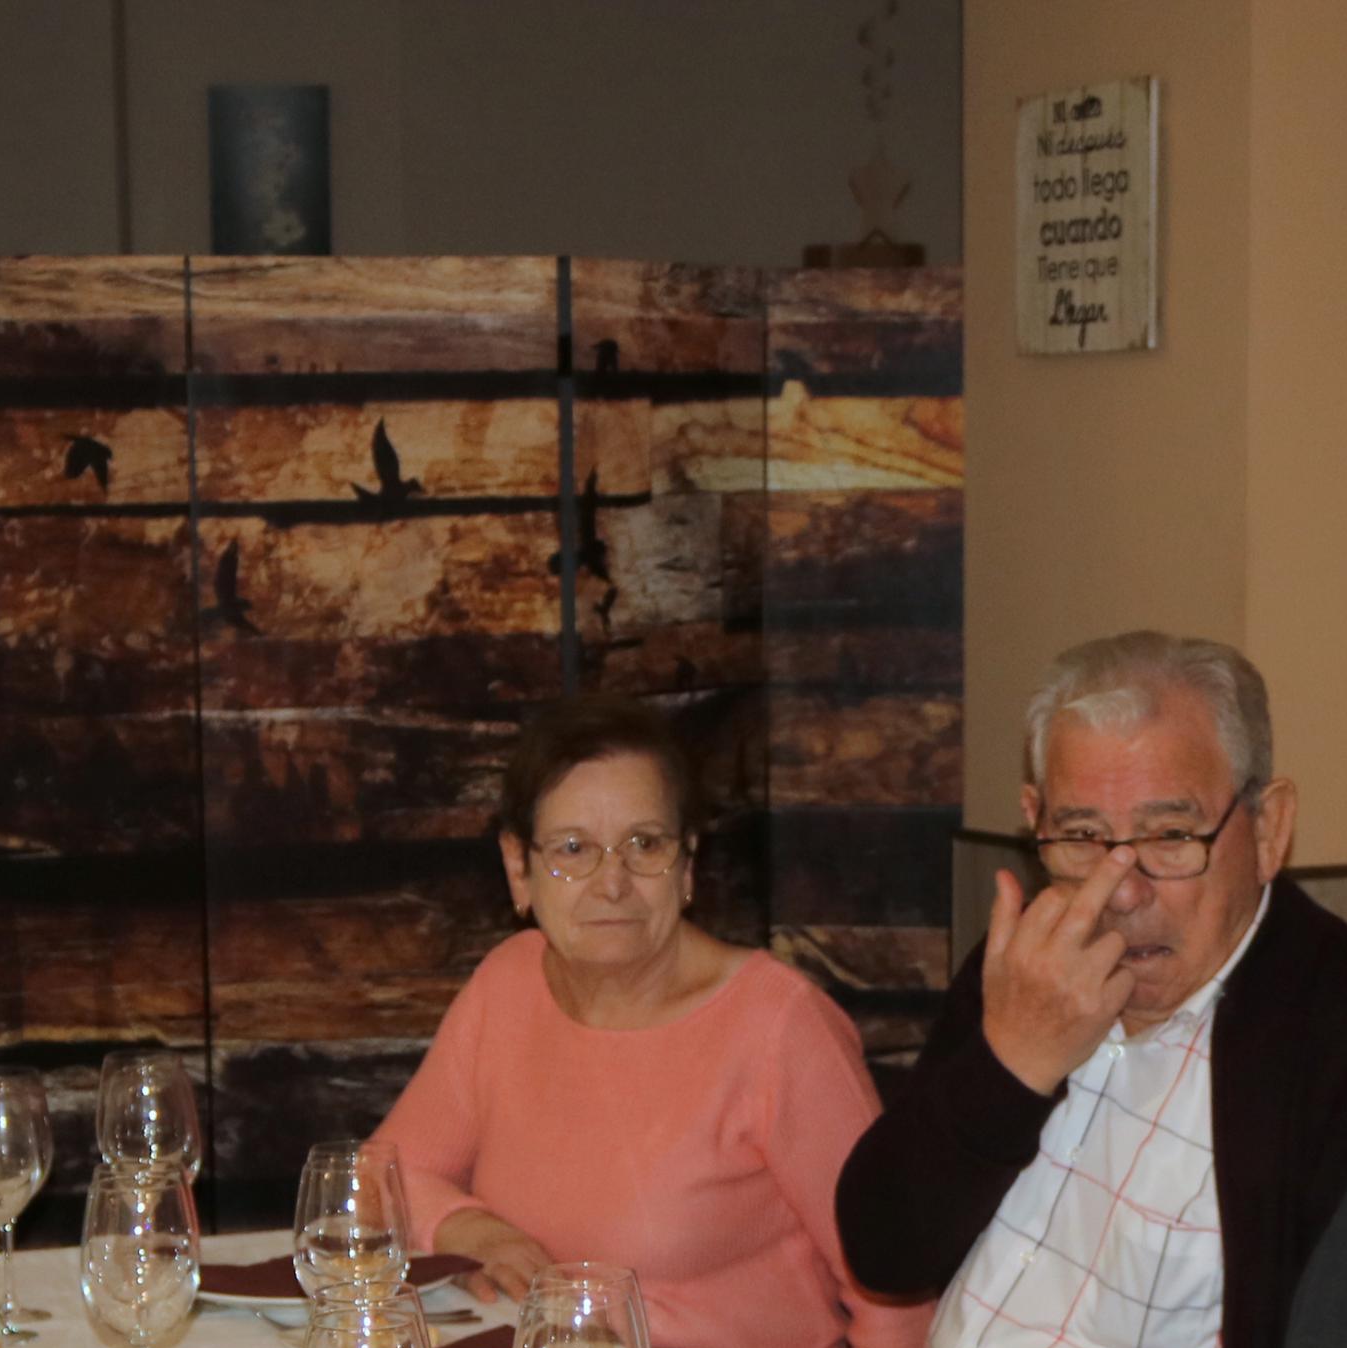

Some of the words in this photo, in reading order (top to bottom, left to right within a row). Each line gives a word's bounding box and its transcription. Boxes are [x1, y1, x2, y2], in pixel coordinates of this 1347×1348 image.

[1033, 171, 1077, 203] todo
[1039, 206, 1123, 247] cuando
[1084, 256, 1119, 283] que
